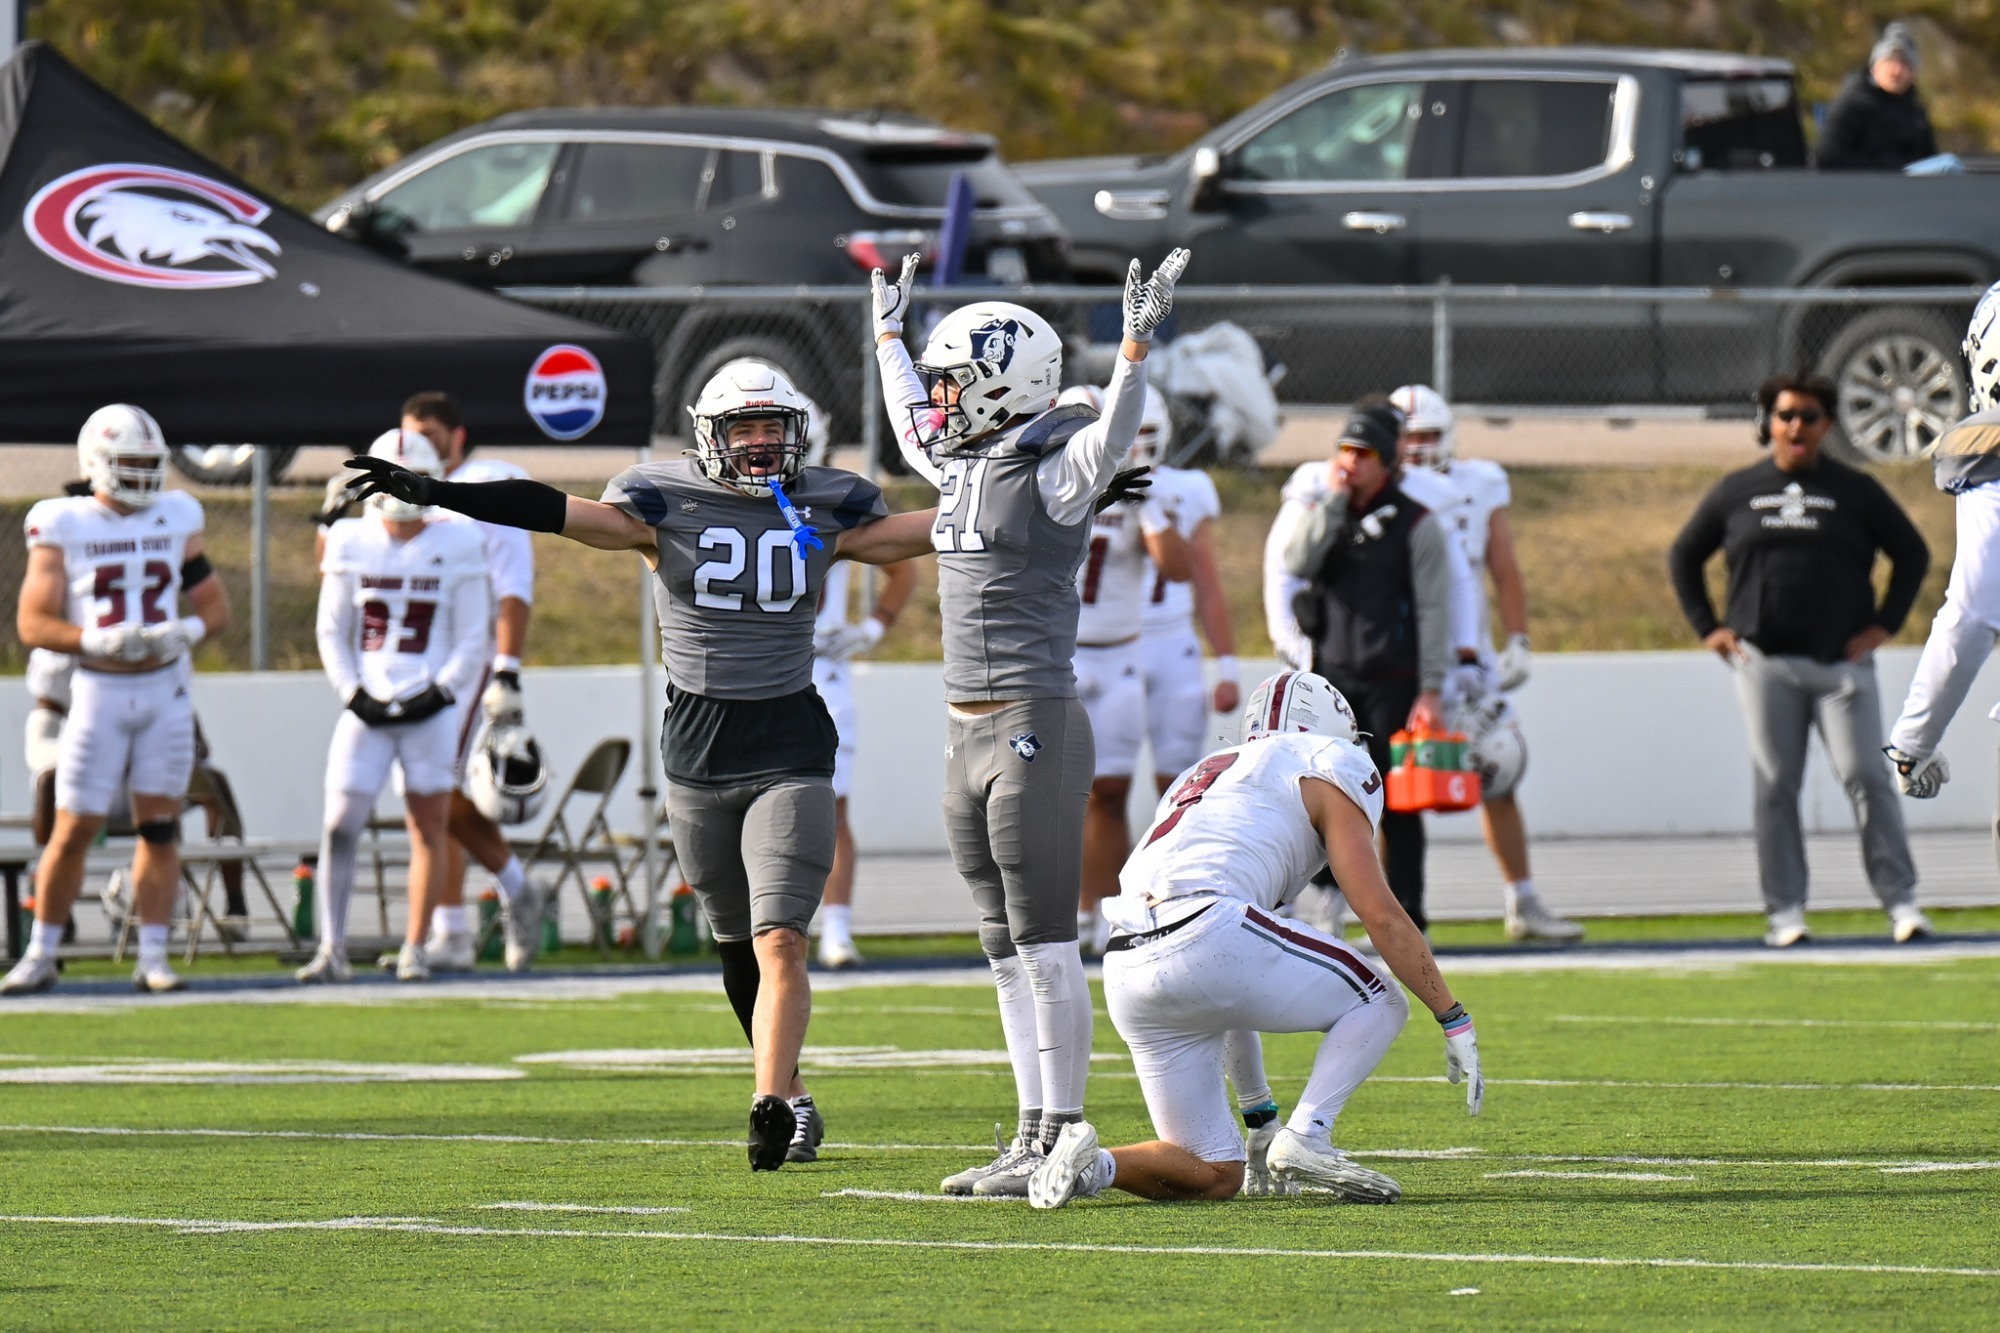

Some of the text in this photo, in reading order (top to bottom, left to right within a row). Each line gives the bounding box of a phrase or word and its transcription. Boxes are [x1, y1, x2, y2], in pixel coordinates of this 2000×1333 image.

[532, 383, 599, 400] PEPSI
[745, 399, 774, 407] Riddell
[929, 457, 987, 553] 21
[94, 560, 172, 628] 52
[693, 526, 807, 613] 20
